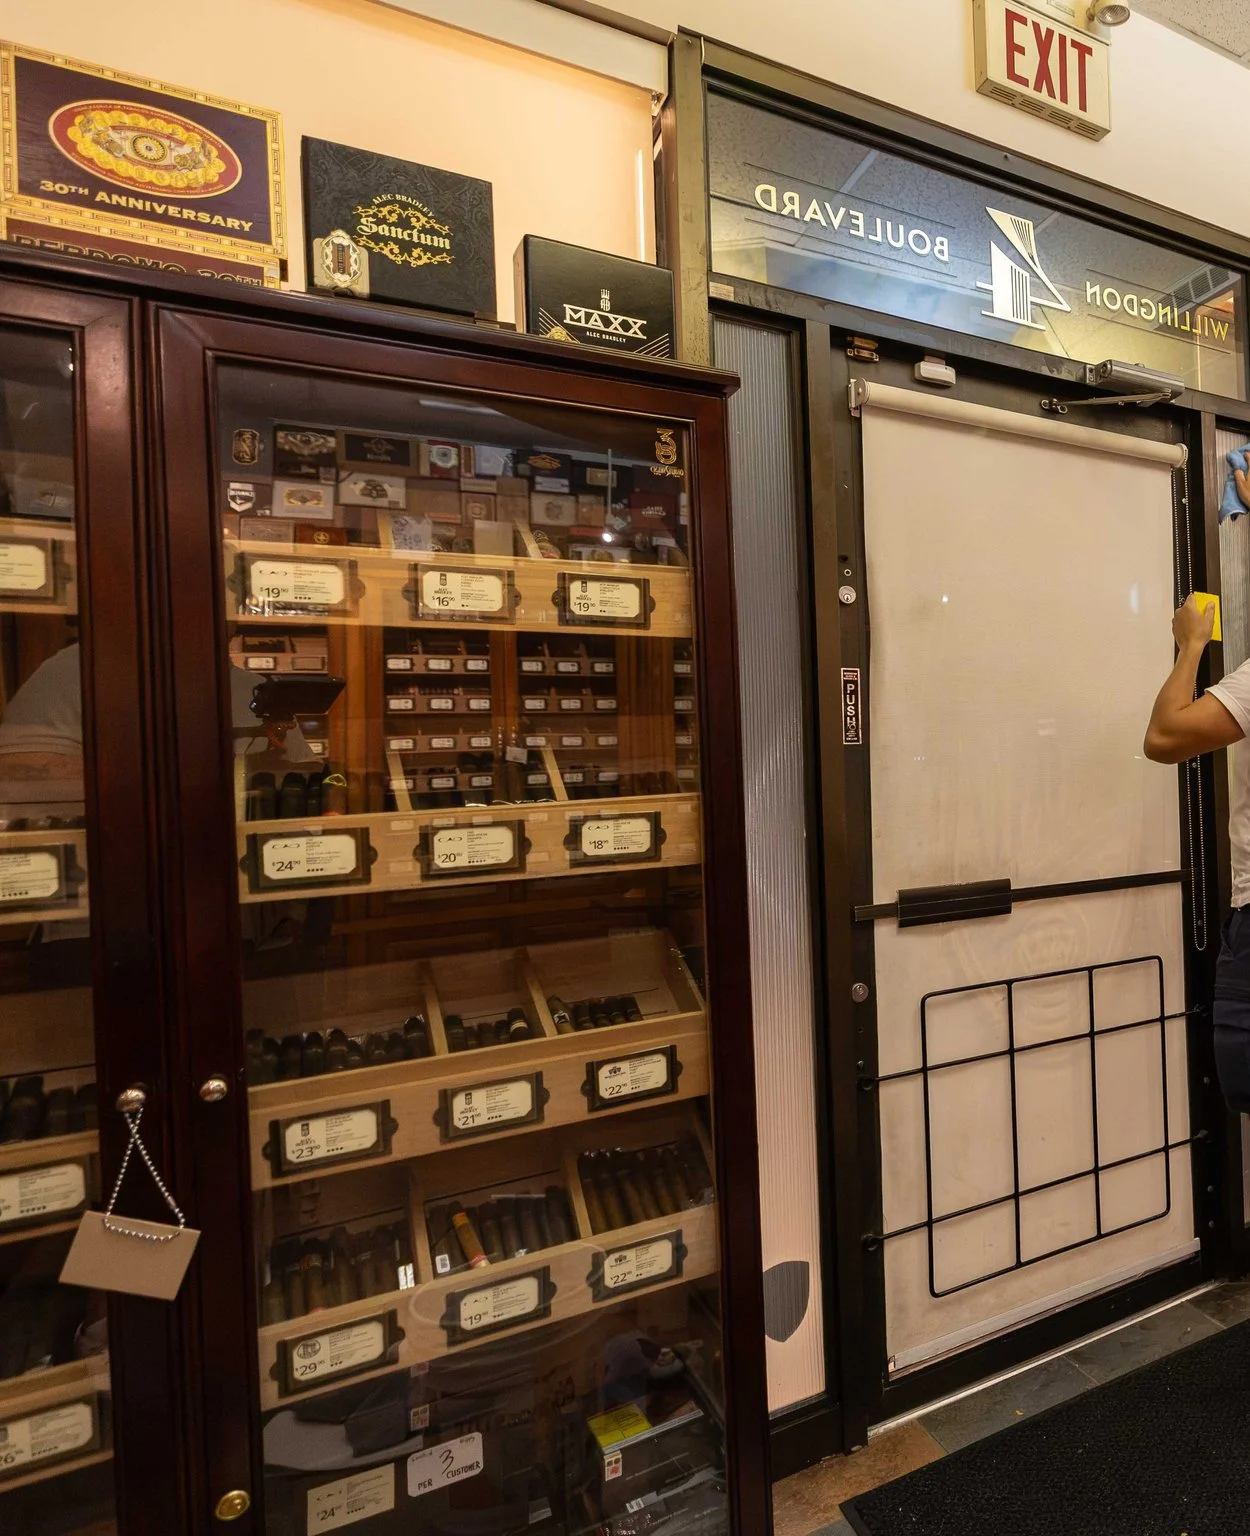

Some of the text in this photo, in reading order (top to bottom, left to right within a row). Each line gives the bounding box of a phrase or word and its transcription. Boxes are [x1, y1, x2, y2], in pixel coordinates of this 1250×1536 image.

[1005, 8, 1093, 113] EXIT
[40, 180, 254, 232] 30TH ANNIVERSARY
[372, 194, 435, 217] ALEC BRADLEY
[357, 217, 450, 249] Sanctum
[563, 304, 647, 339] MAXX
[602, 334, 626, 343] BRADLEY
[846, 683, 857, 728] PUSH
[418, 1461, 480, 1490] PER CUSTOMER
[440, 1449, 454, 1475] 3
